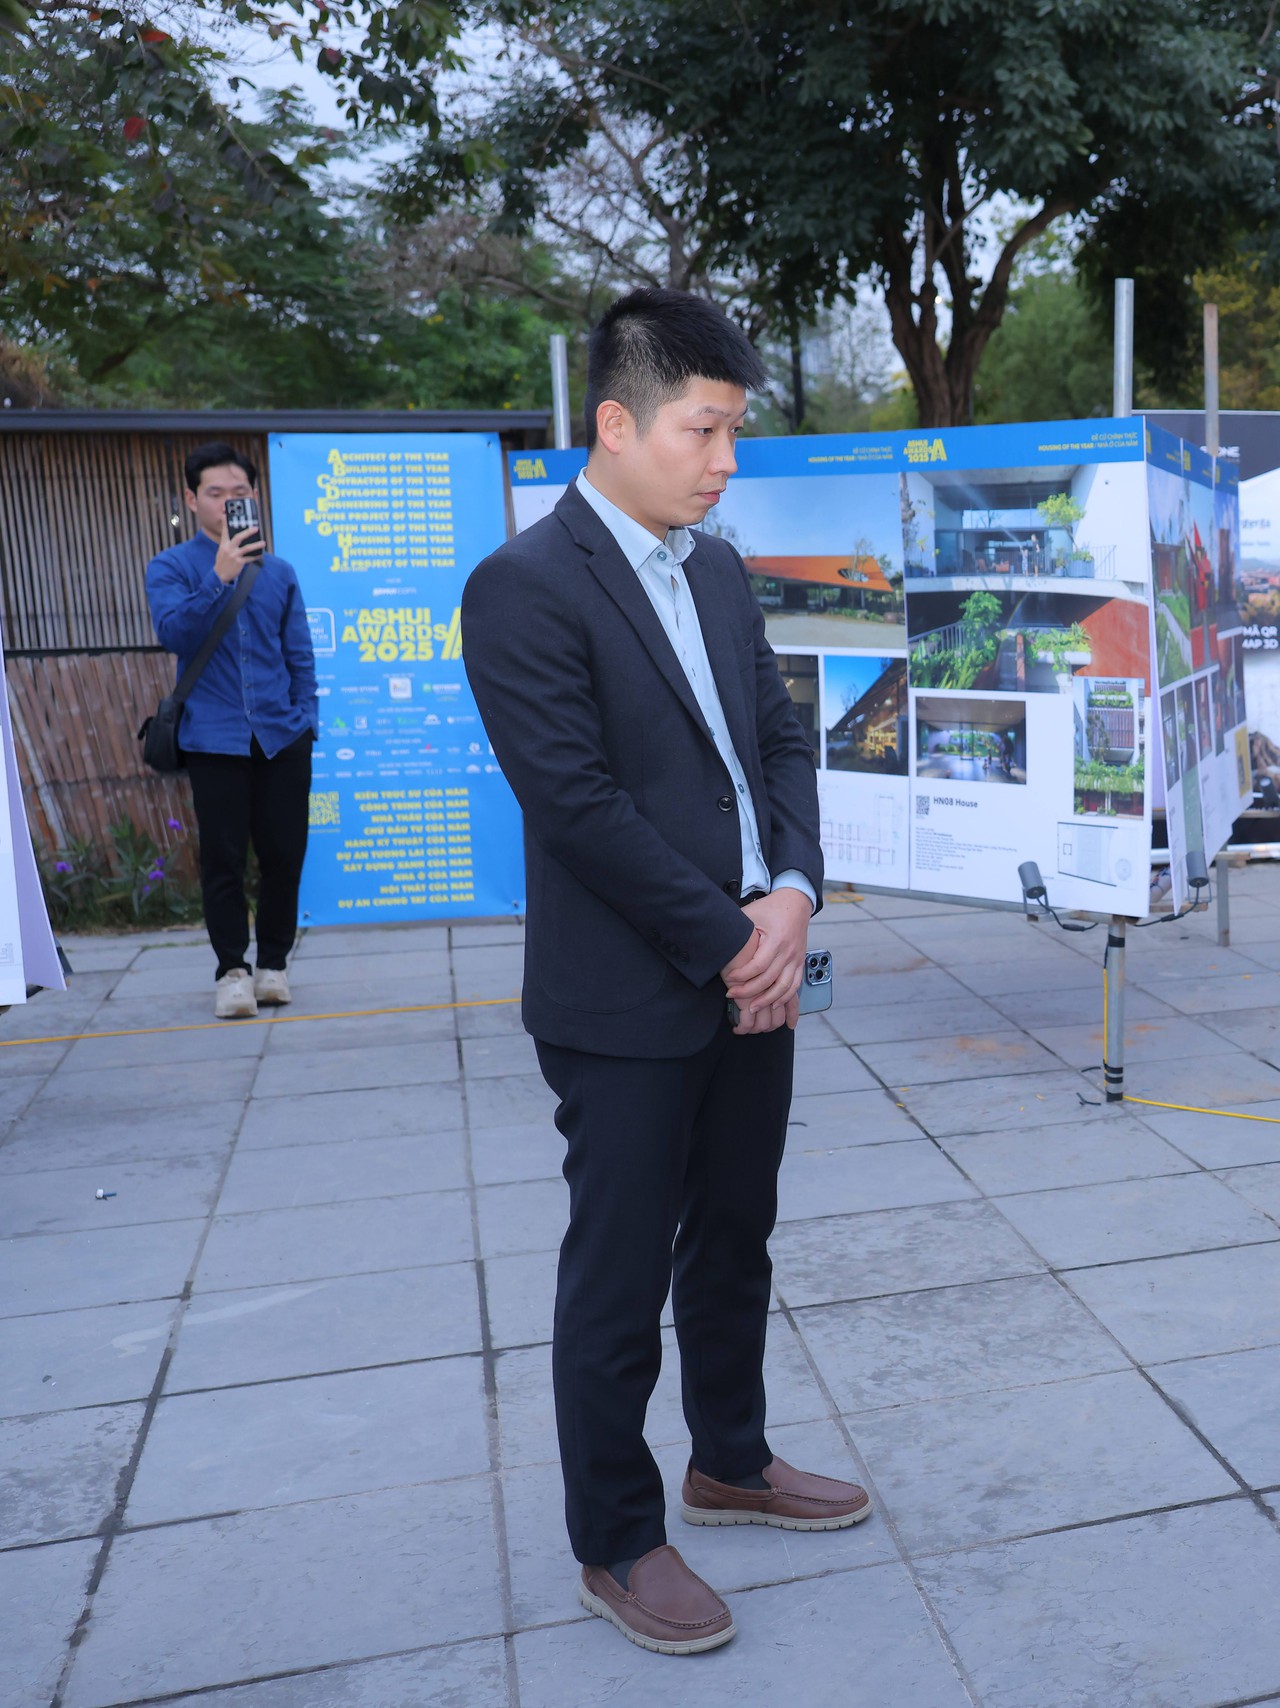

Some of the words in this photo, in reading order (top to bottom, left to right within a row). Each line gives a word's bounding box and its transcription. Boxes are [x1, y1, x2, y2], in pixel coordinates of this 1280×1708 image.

[1038, 444, 1061, 452] HOUSING
[328, 448, 386, 464] ARCHITECT
[389, 453, 402, 461] OF
[404, 453, 422, 461] THE
[424, 453, 449, 461] YEAR
[908, 454, 929, 463] 2025
[333, 462, 388, 476] BUILDING
[389, 465, 403, 473] OF
[405, 465, 423, 473] THE
[425, 465, 450, 473] YEAR
[317, 474, 388, 489] CONTRACTOR
[390, 477, 404, 485] OF
[406, 477, 424, 485] THE
[426, 477, 451, 485] YEAR
[326, 486, 389, 500] DEVELOPER
[391, 488, 404, 496] OF
[406, 488, 424, 496] THE
[426, 488, 451, 497] YEAR
[391, 500, 405, 508] OF
[407, 500, 425, 508] THE
[427, 500, 452, 508] YEAR
[304, 509, 346, 524] FUTURE
[348, 512, 390, 520] PROJECT
[392, 512, 405, 520] OF
[408, 512, 426, 520] THE
[428, 512, 453, 520] YEAR
[317, 521, 358, 536] GREEN
[360, 524, 390, 532] BUILD
[392, 524, 406, 532] OF
[408, 524, 426, 532] THE
[429, 524, 453, 532] YEAR
[338, 533, 391, 548] HOUSING
[393, 535, 407, 544] OF
[409, 535, 427, 544] THE
[429, 535, 454, 544] YEAR
[342, 546, 391, 559] INTERIOR
[394, 547, 407, 556] OF
[410, 547, 428, 556] THE
[430, 547, 455, 556] YEAR
[351, 559, 392, 568] PROJECT
[395, 559, 408, 567] OF
[410, 559, 428, 567] THE
[431, 559, 455, 567] YEAR
[357, 607, 431, 625] ASHUI
[341, 623, 449, 643] AWARDS
[358, 641, 434, 663] 2025
[933, 796, 954, 806] HN08
[955, 798, 978, 808] House
